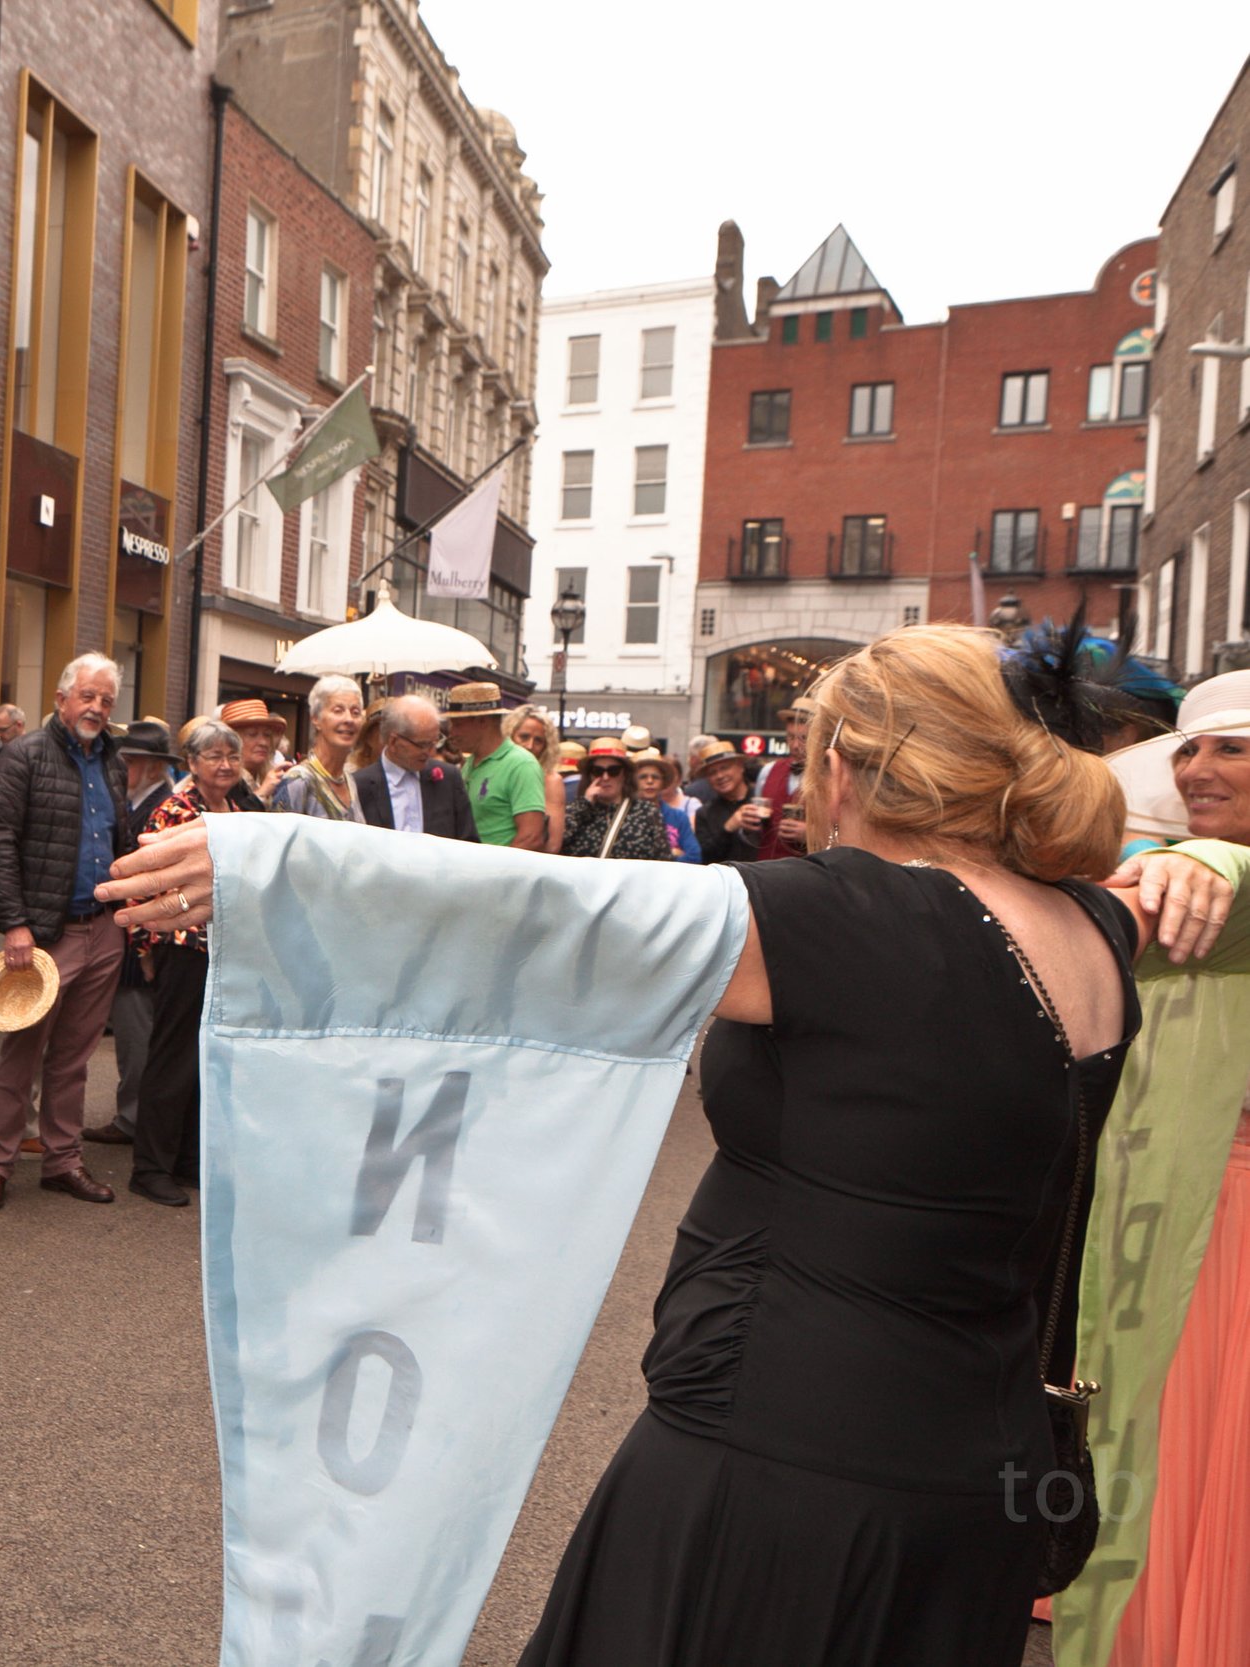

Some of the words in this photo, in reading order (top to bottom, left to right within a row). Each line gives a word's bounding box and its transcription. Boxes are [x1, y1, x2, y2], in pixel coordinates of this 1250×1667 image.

[121, 526, 170, 565] NESPRESSO
[431, 570, 487, 594] Mulberry
[539, 706, 631, 729] artens
